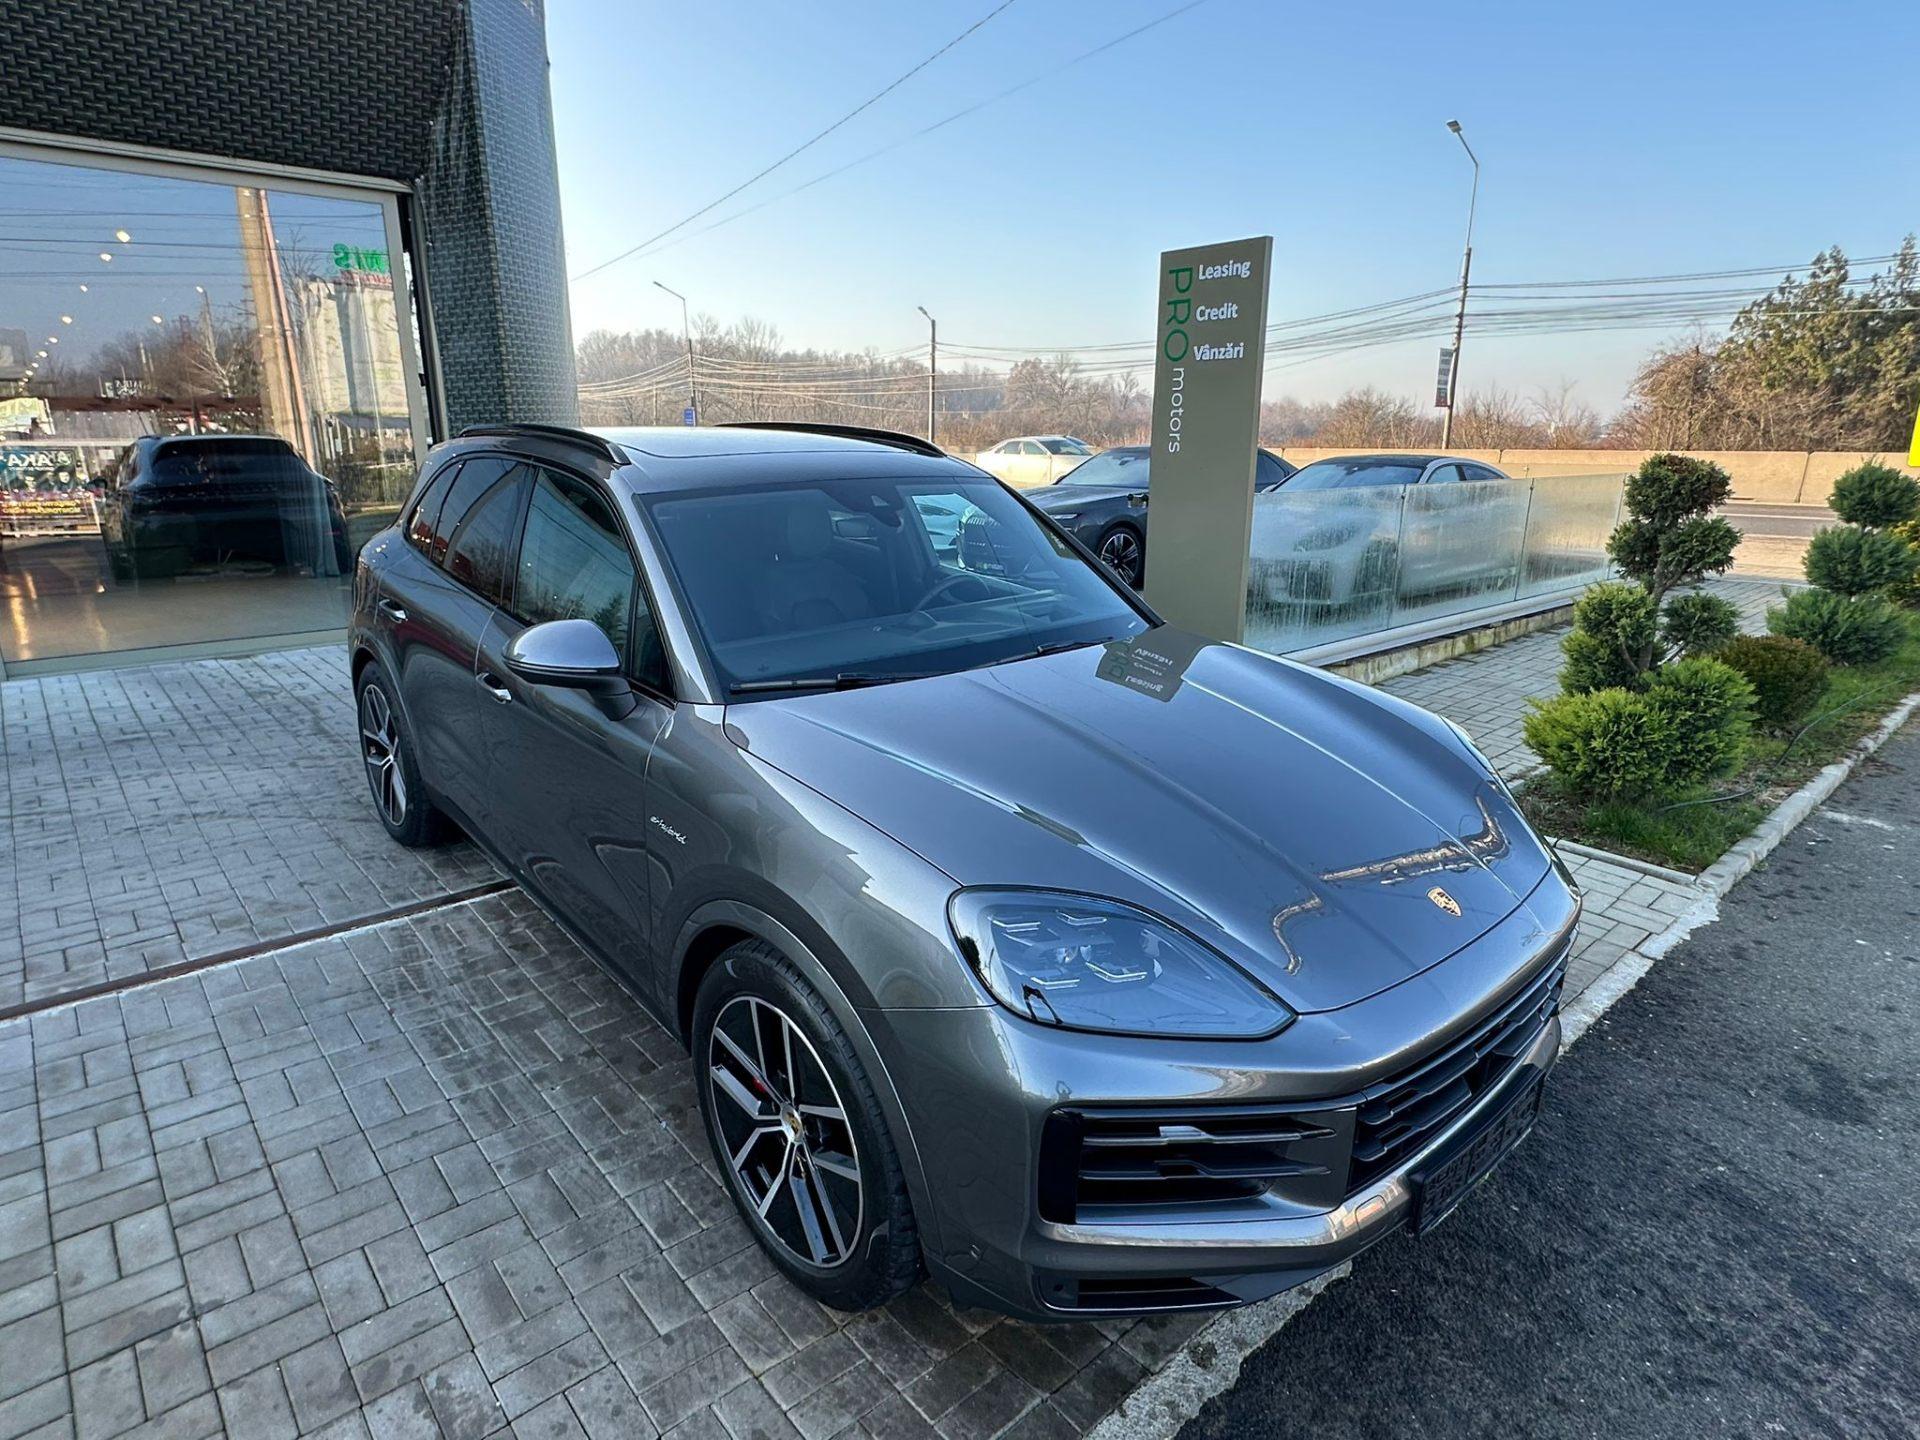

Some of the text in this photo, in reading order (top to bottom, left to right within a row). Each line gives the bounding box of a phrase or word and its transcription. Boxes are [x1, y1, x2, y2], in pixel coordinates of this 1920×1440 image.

[1198, 260, 1251, 280] Leasing
[1195, 303, 1238, 322] Credit
[1164, 267, 1193, 453] PRO motors
[1193, 342, 1244, 361] Vânzări
